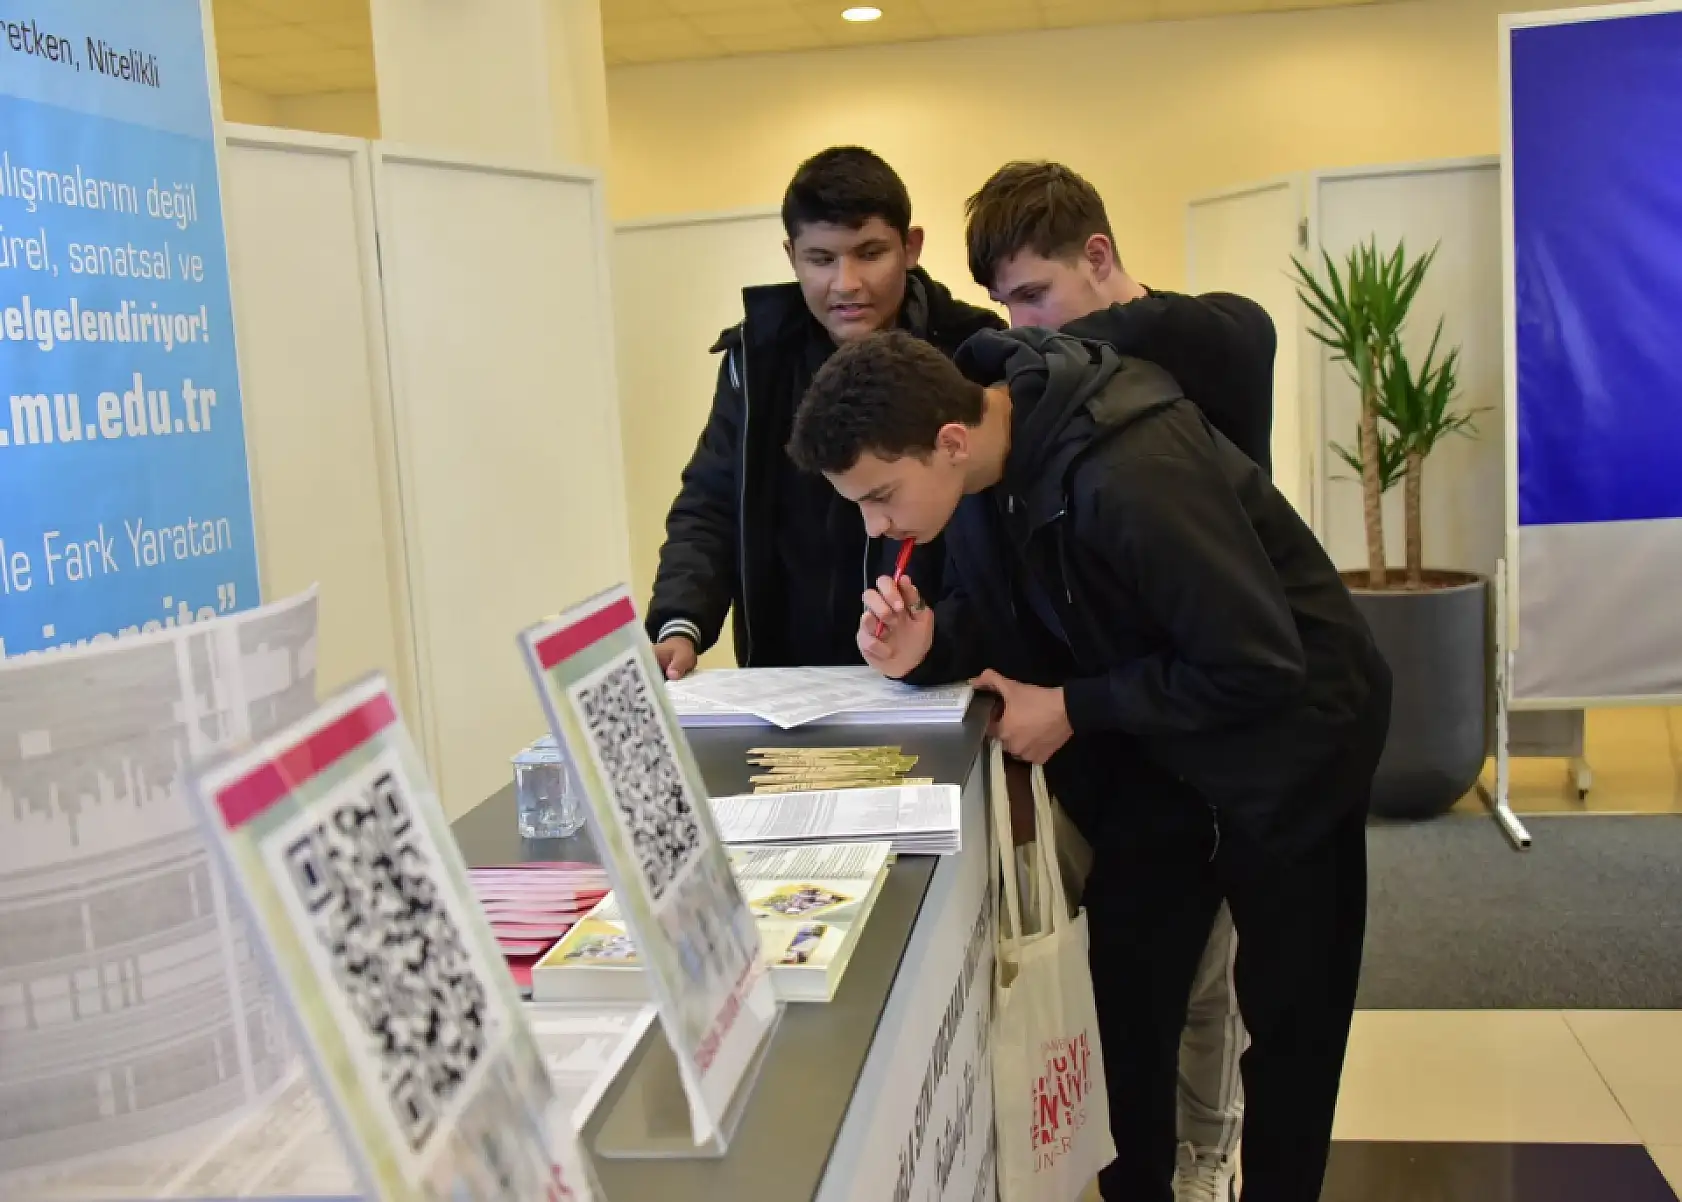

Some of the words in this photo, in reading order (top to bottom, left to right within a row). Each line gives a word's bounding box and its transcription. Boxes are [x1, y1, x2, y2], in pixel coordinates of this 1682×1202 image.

[86, 36, 160, 88] Nitelikli
[147, 178, 197, 230] değil
[69, 241, 171, 281] sanatsal
[179, 252, 204, 282] ve
[0, 372, 216, 445] .mu.edu.tr
[43, 522, 120, 585] Fark
[124, 516, 232, 567] Yaratan
